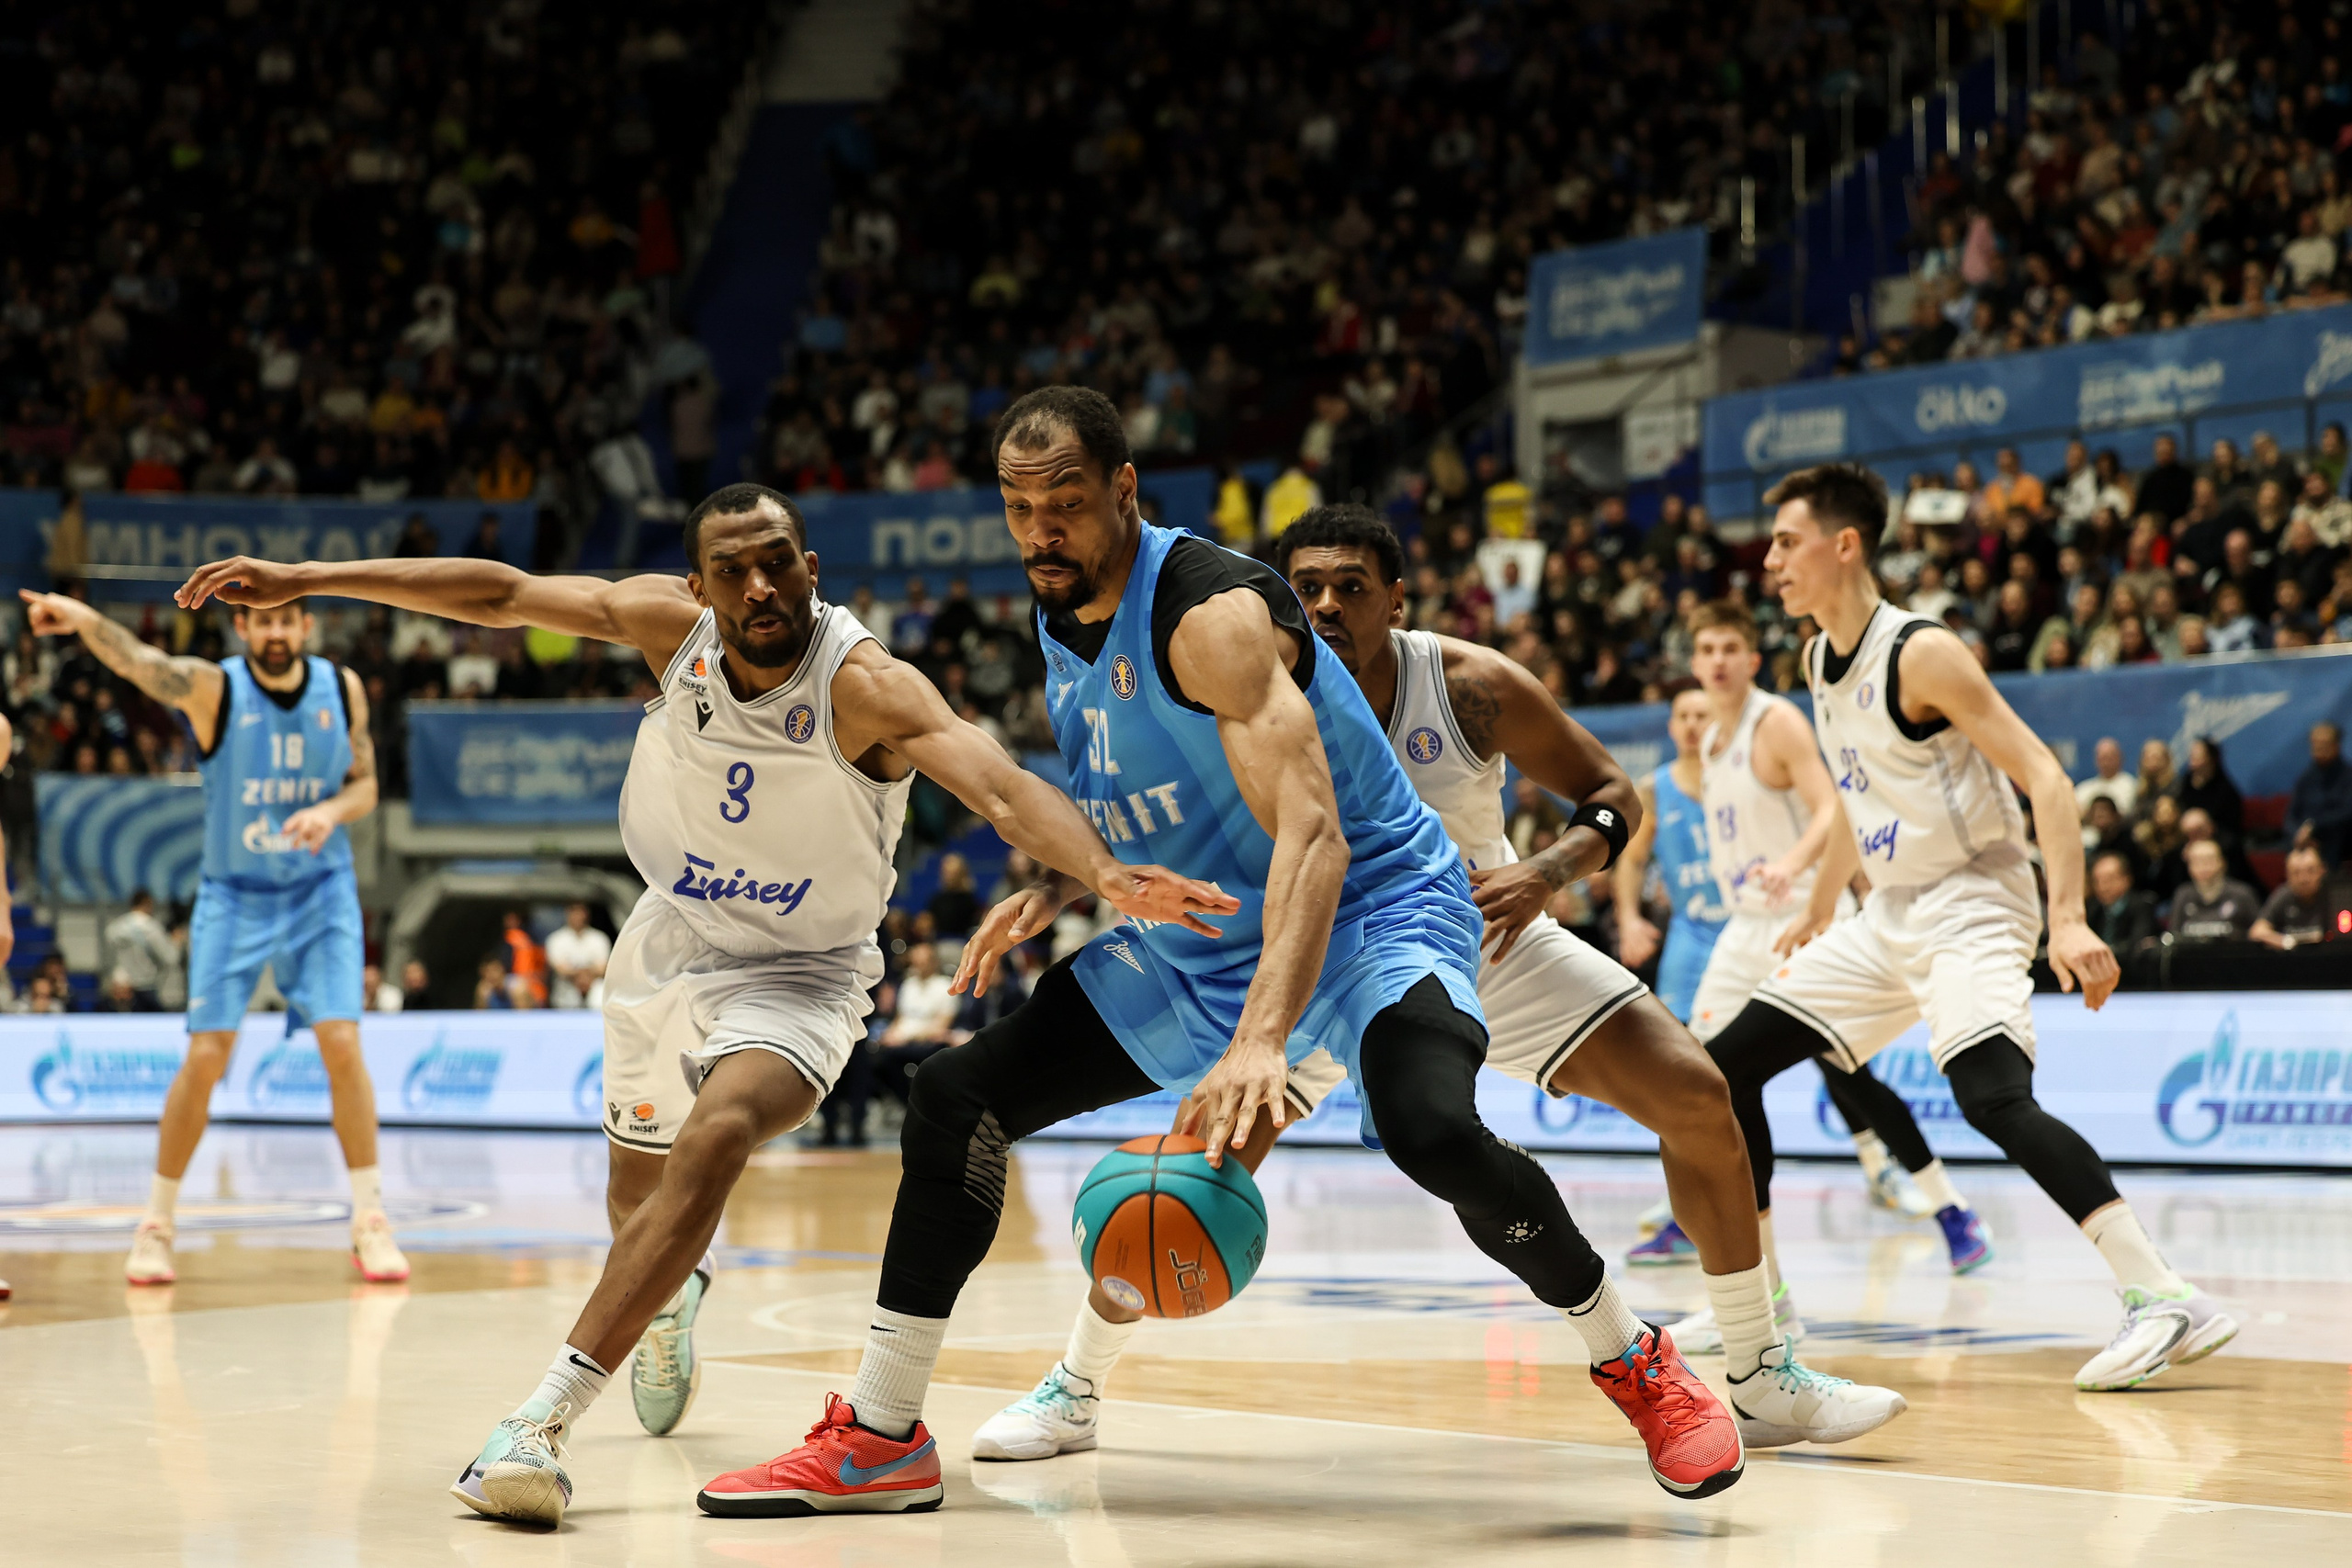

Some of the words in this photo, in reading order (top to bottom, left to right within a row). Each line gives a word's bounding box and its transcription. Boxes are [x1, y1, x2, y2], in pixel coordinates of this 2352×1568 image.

[873, 516, 1025, 568] ПОБ
[678, 677, 707, 694] ENISEY
[270, 733, 304, 769] 18
[242, 778, 326, 806] ZENIT
[719, 761, 754, 823] 3
[1858, 818, 1900, 862] isey
[628, 1124, 660, 1134] ENISEY
[1505, 1224, 1544, 1243] KELME
